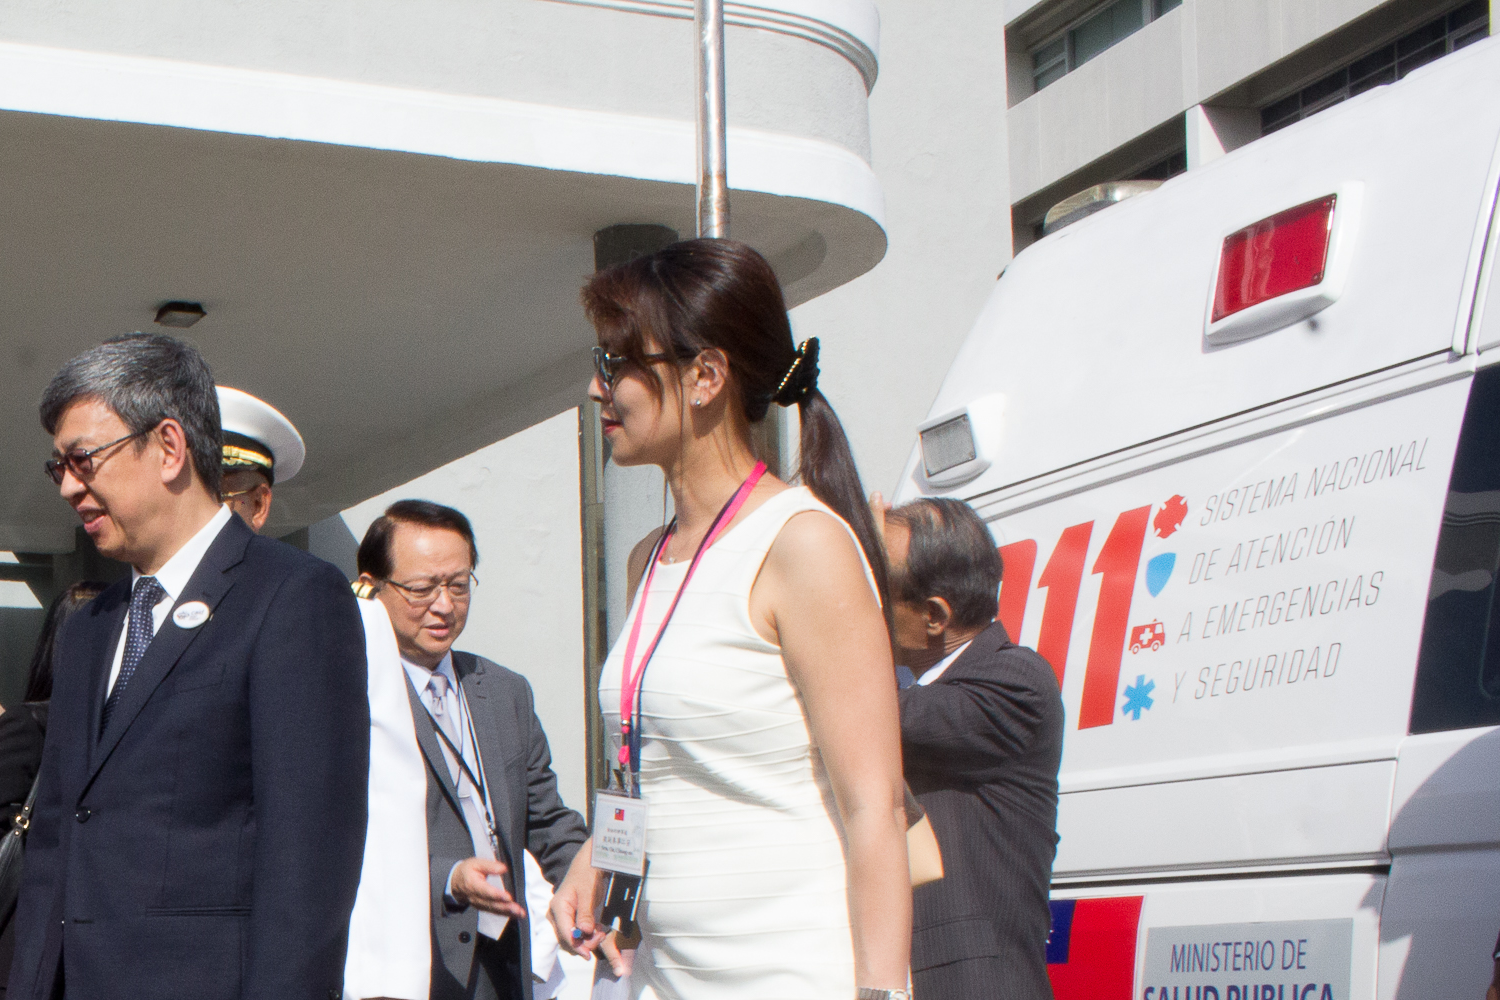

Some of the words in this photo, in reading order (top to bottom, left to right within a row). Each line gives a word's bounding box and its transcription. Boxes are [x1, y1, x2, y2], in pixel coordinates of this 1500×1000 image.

[1200, 472, 1298, 527] SISTEMA
[1304, 437, 1429, 499] NACIONAL
[1188, 548, 1221, 584] DE
[1225, 515, 1355, 576] ATENCIÓN
[1176, 611, 1193, 644] A
[1202, 570, 1384, 639] EMERGENCIAS
[1172, 670, 1187, 703] Y
[1194, 642, 1342, 700] SEGURIDAD
[1170, 939, 1275, 973] MINISTERIO
[1280, 938, 1308, 971] DE
